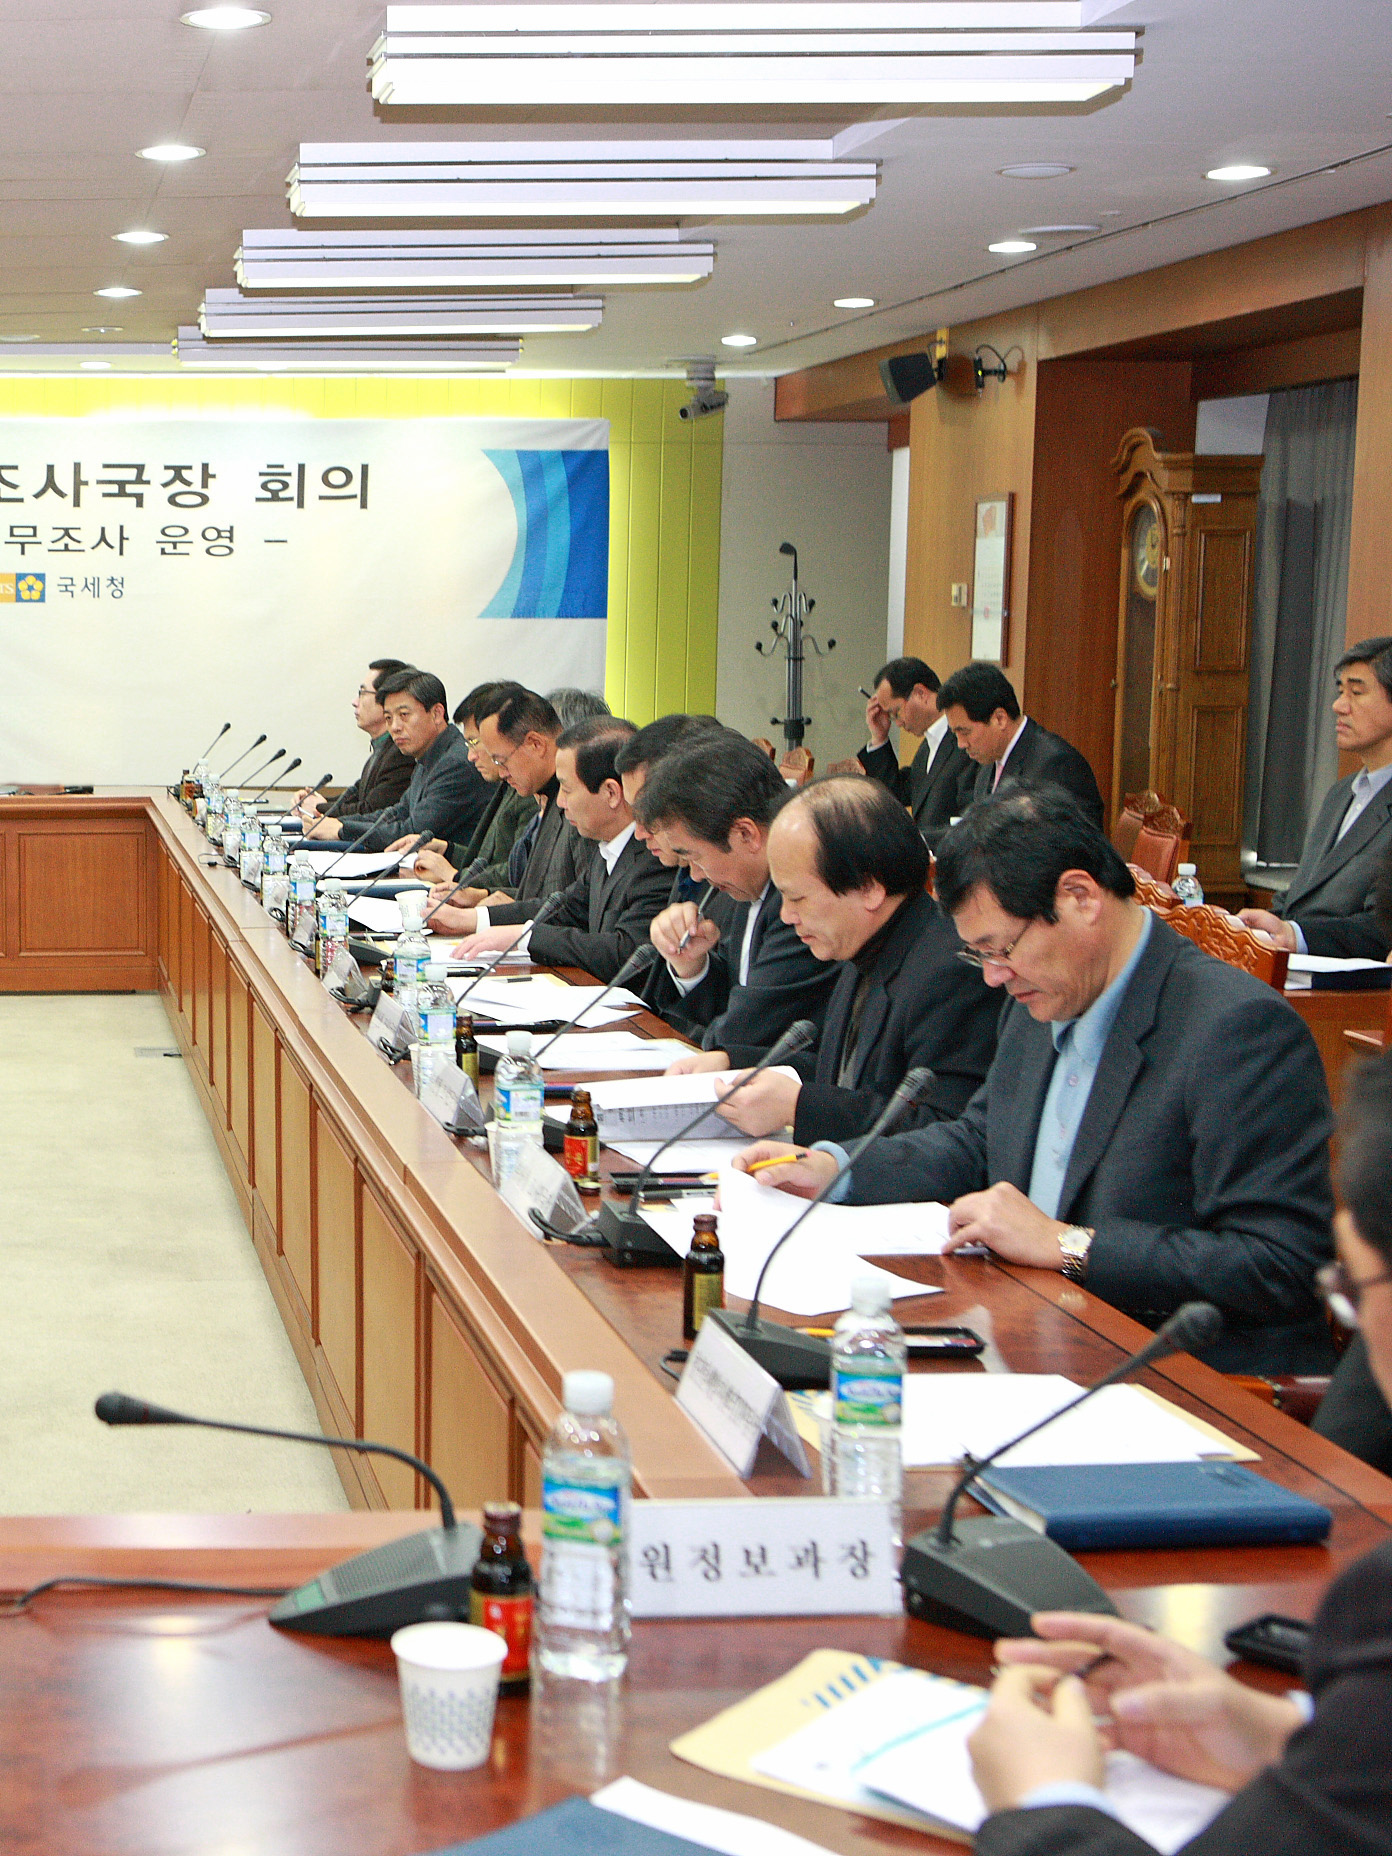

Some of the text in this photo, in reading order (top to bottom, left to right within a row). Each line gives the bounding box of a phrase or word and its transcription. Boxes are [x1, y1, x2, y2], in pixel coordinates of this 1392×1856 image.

[254, 462, 370, 511] 회의
[155, 524, 235, 558] 운영
[56, 575, 126, 600] 국세청
